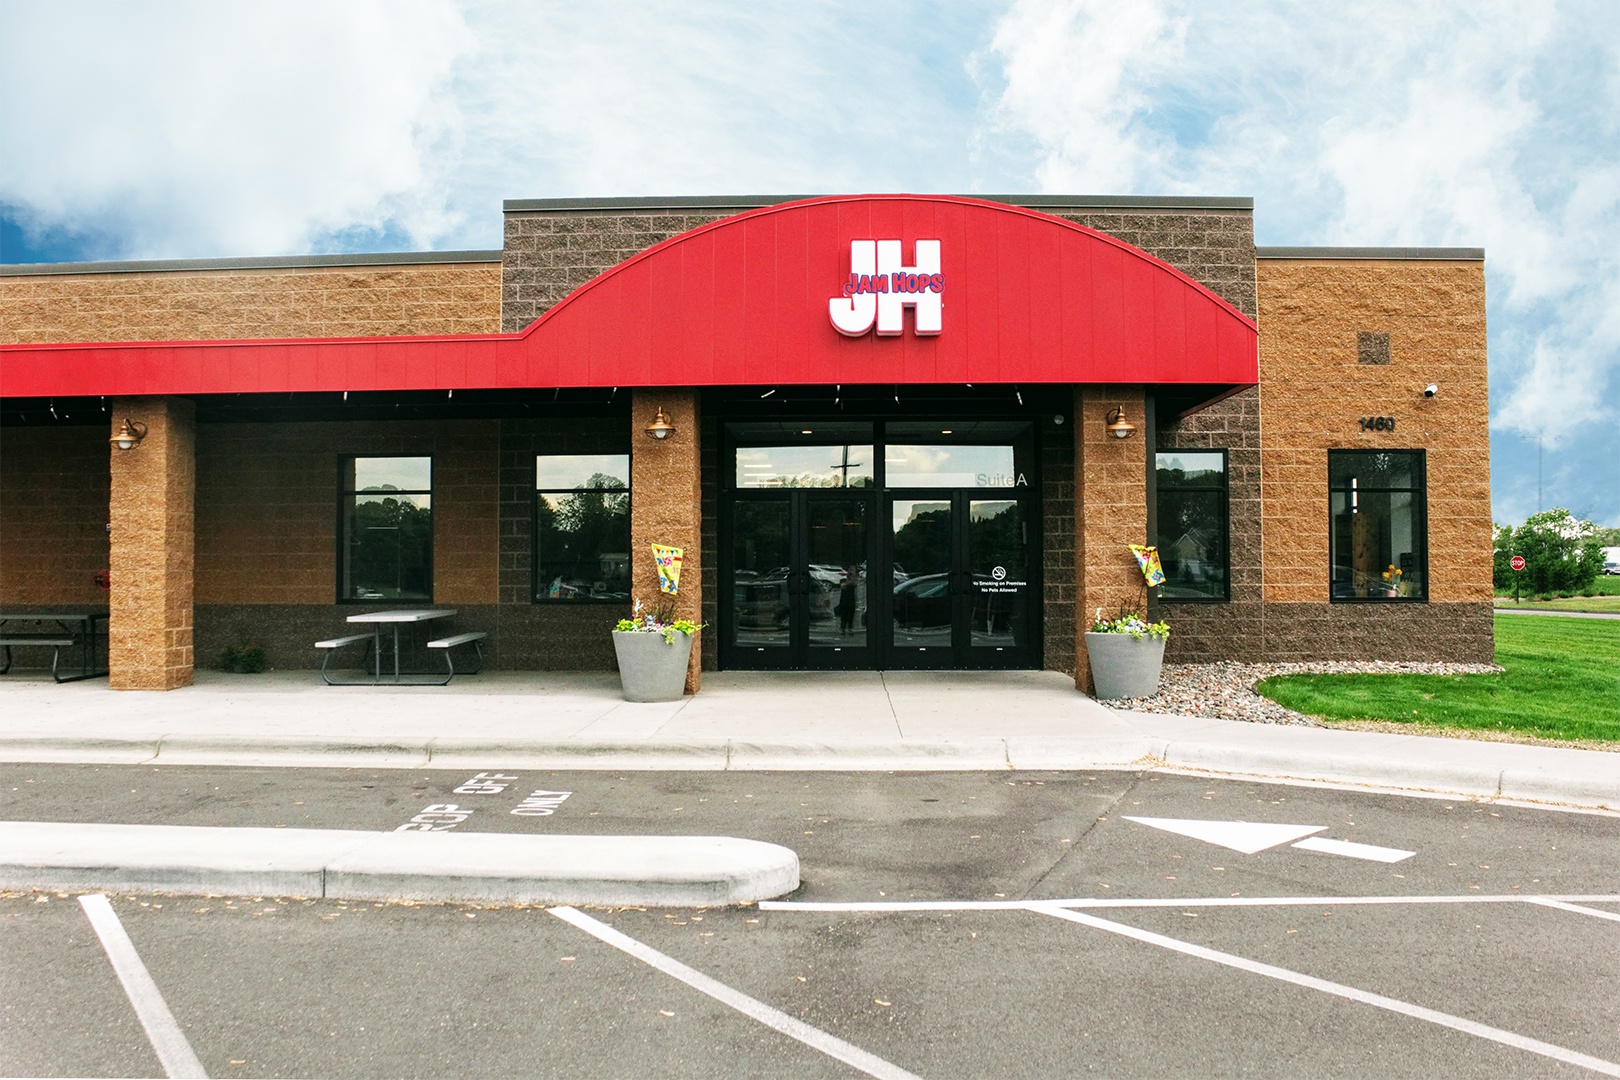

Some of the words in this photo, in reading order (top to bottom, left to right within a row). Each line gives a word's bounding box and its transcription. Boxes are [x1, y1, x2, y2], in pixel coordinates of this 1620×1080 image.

[829, 239, 942, 335] JH
[844, 272, 889, 294] JAM
[891, 271, 945, 294] HOPS
[1358, 416, 1396, 432] 1460
[977, 473, 1015, 487] Suite
[1016, 472, 1028, 487] A
[392, 803, 474, 833] ROP
[452, 772, 519, 795] OFF
[510, 789, 573, 817] ONLY
